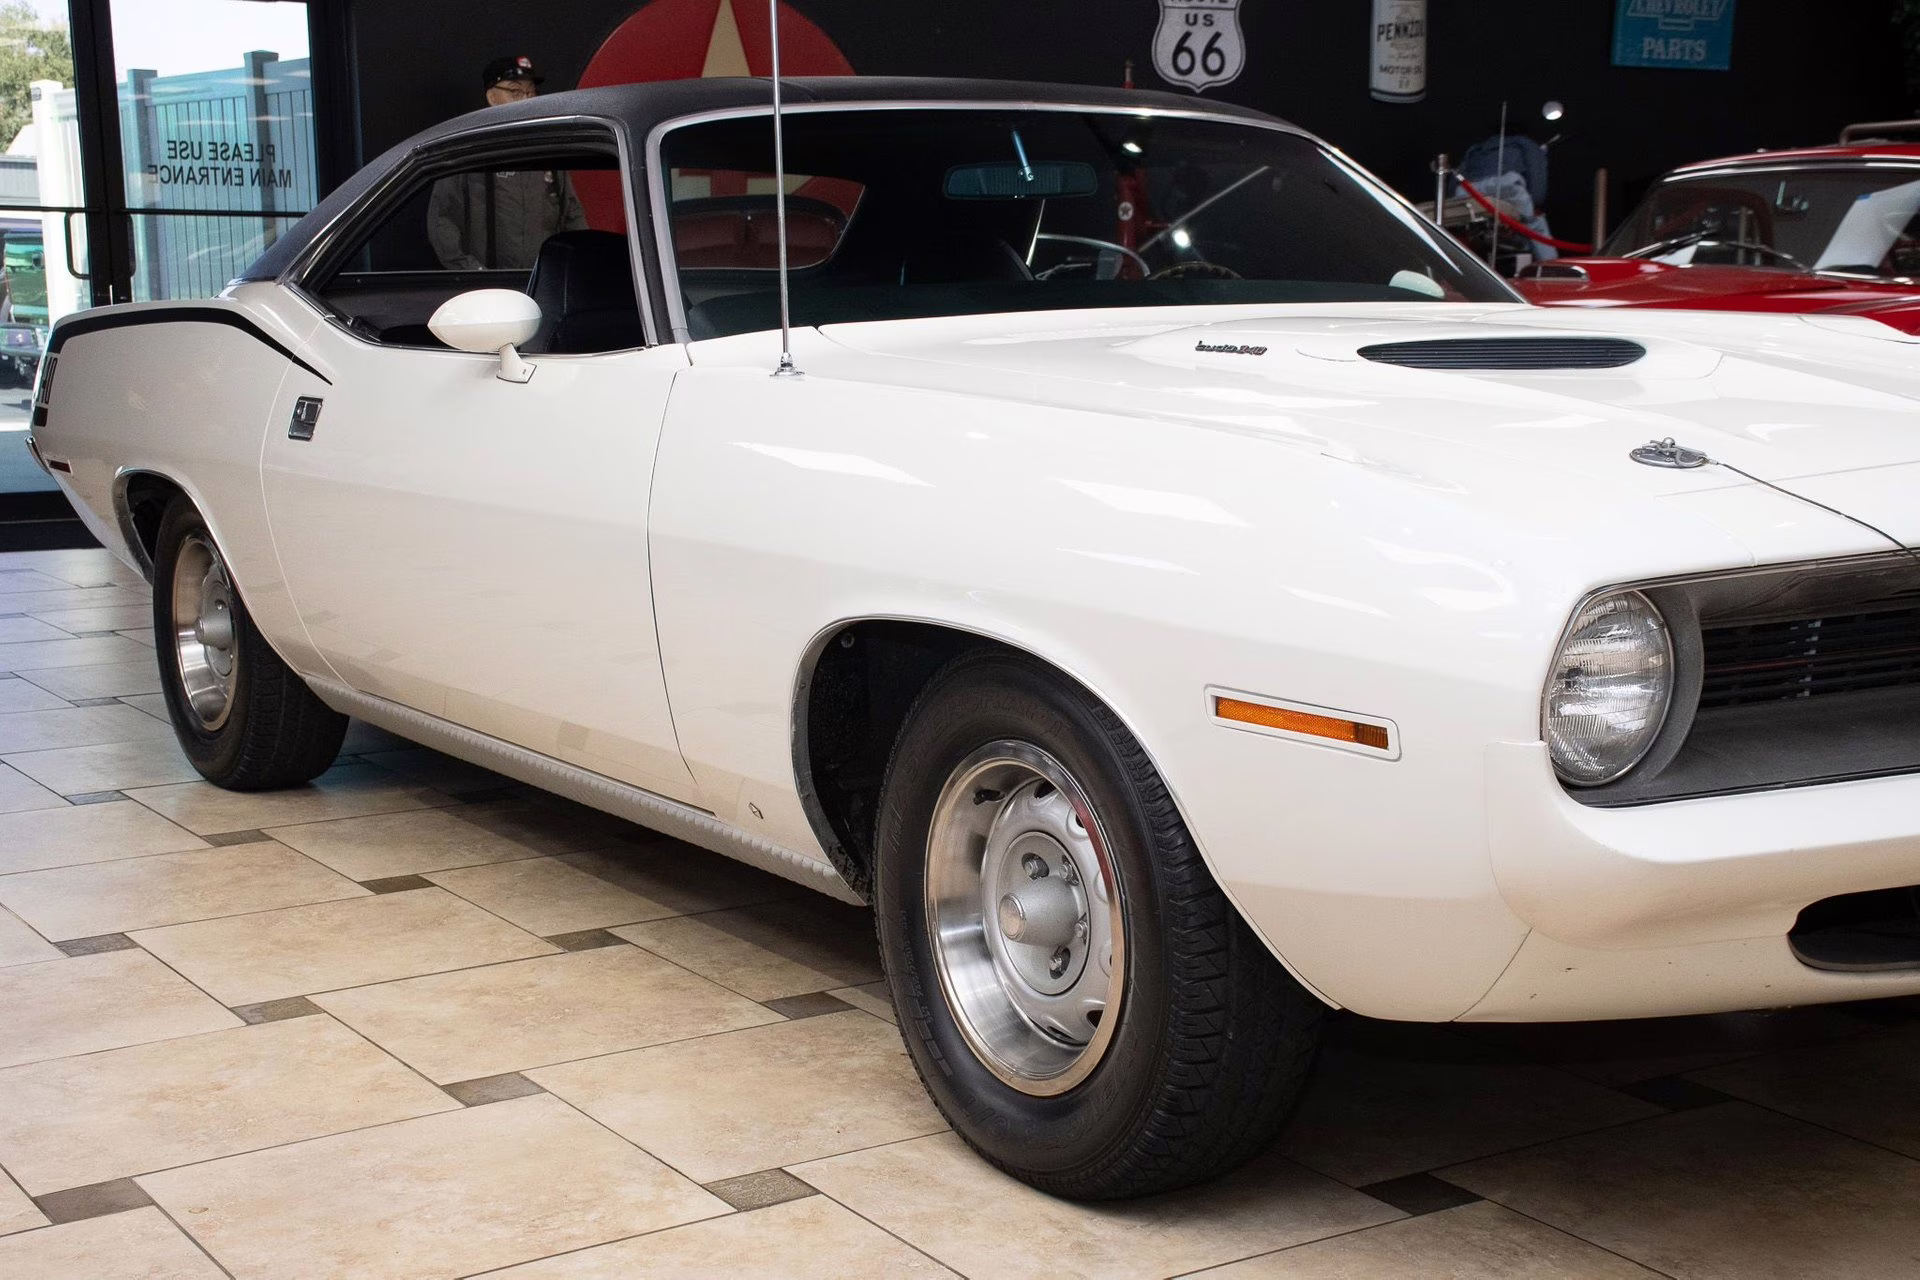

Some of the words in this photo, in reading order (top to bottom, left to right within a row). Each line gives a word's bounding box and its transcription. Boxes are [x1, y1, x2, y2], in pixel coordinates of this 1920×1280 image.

[1185, 13, 1215, 27] US
[1172, 31, 1226, 76] 66
[1641, 37, 1707, 61] PARTS
